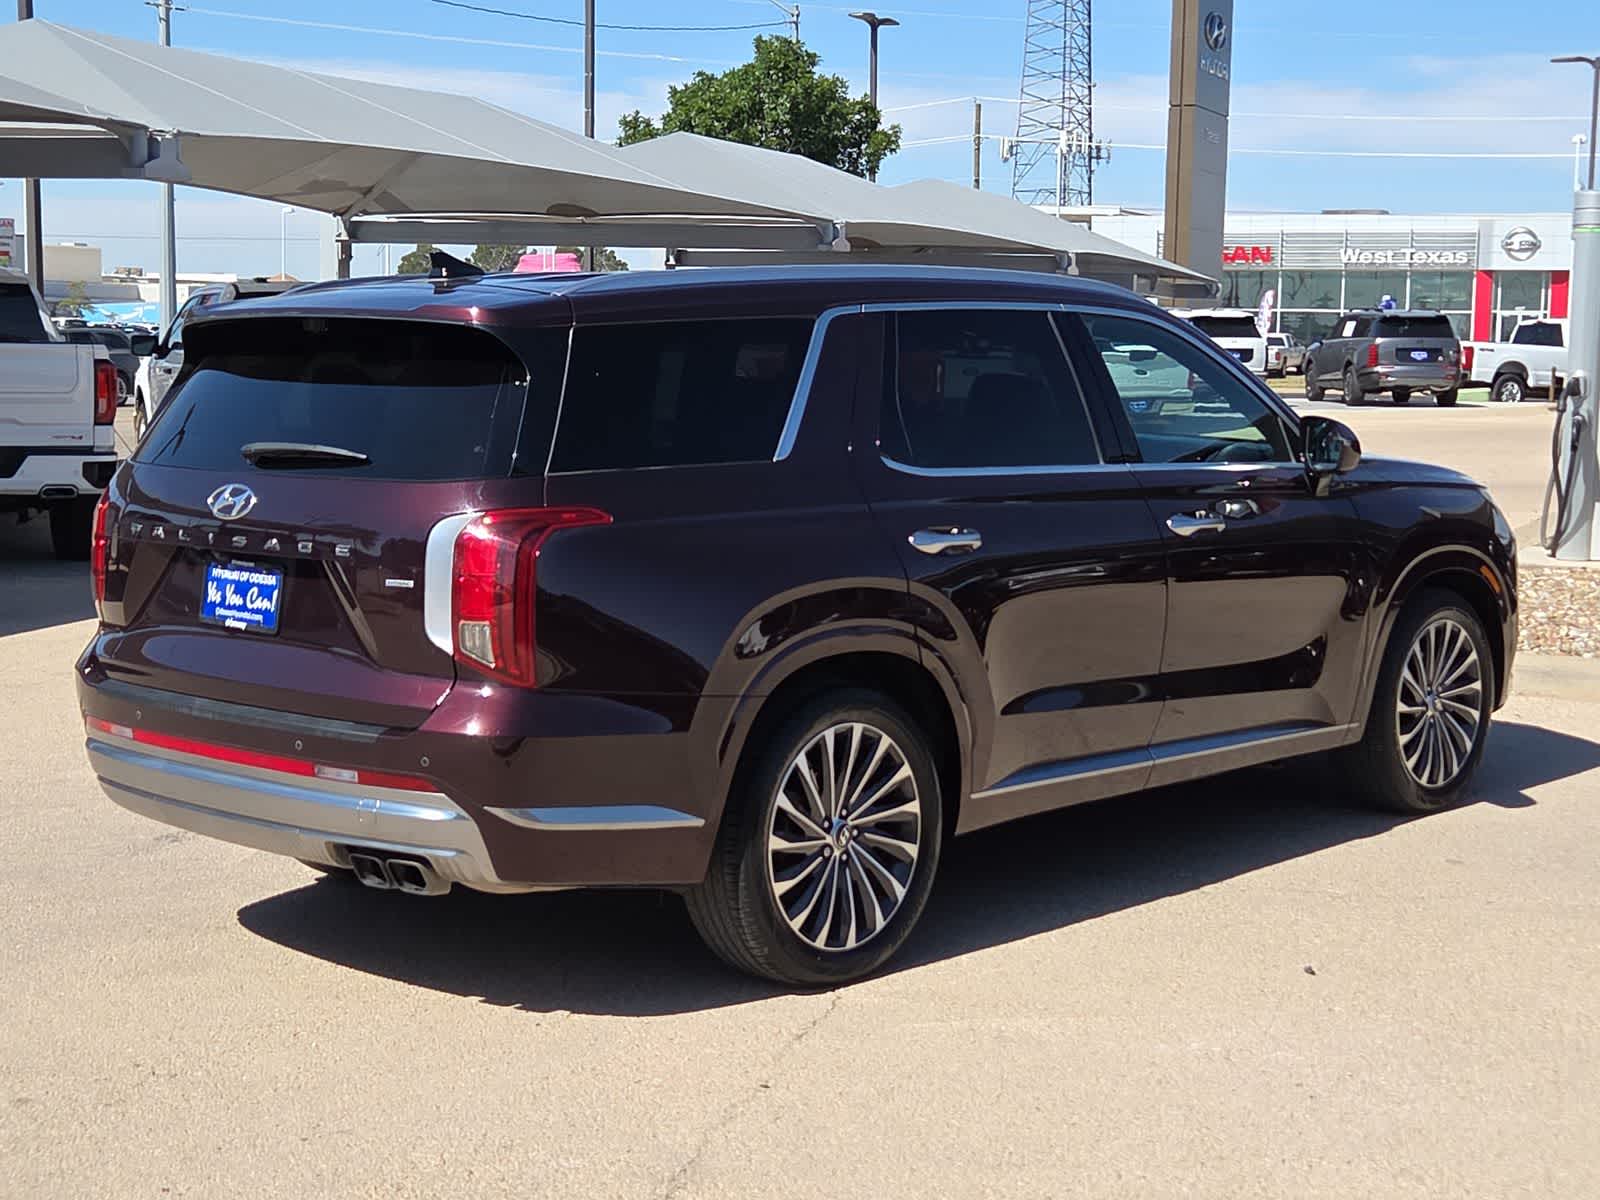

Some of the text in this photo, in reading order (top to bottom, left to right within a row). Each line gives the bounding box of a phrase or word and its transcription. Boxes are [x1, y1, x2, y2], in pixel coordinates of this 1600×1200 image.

[1339, 248, 1468, 263] West Texas
[130, 523, 351, 557] PALISADE
[207, 581, 279, 613] Yes You Can!
